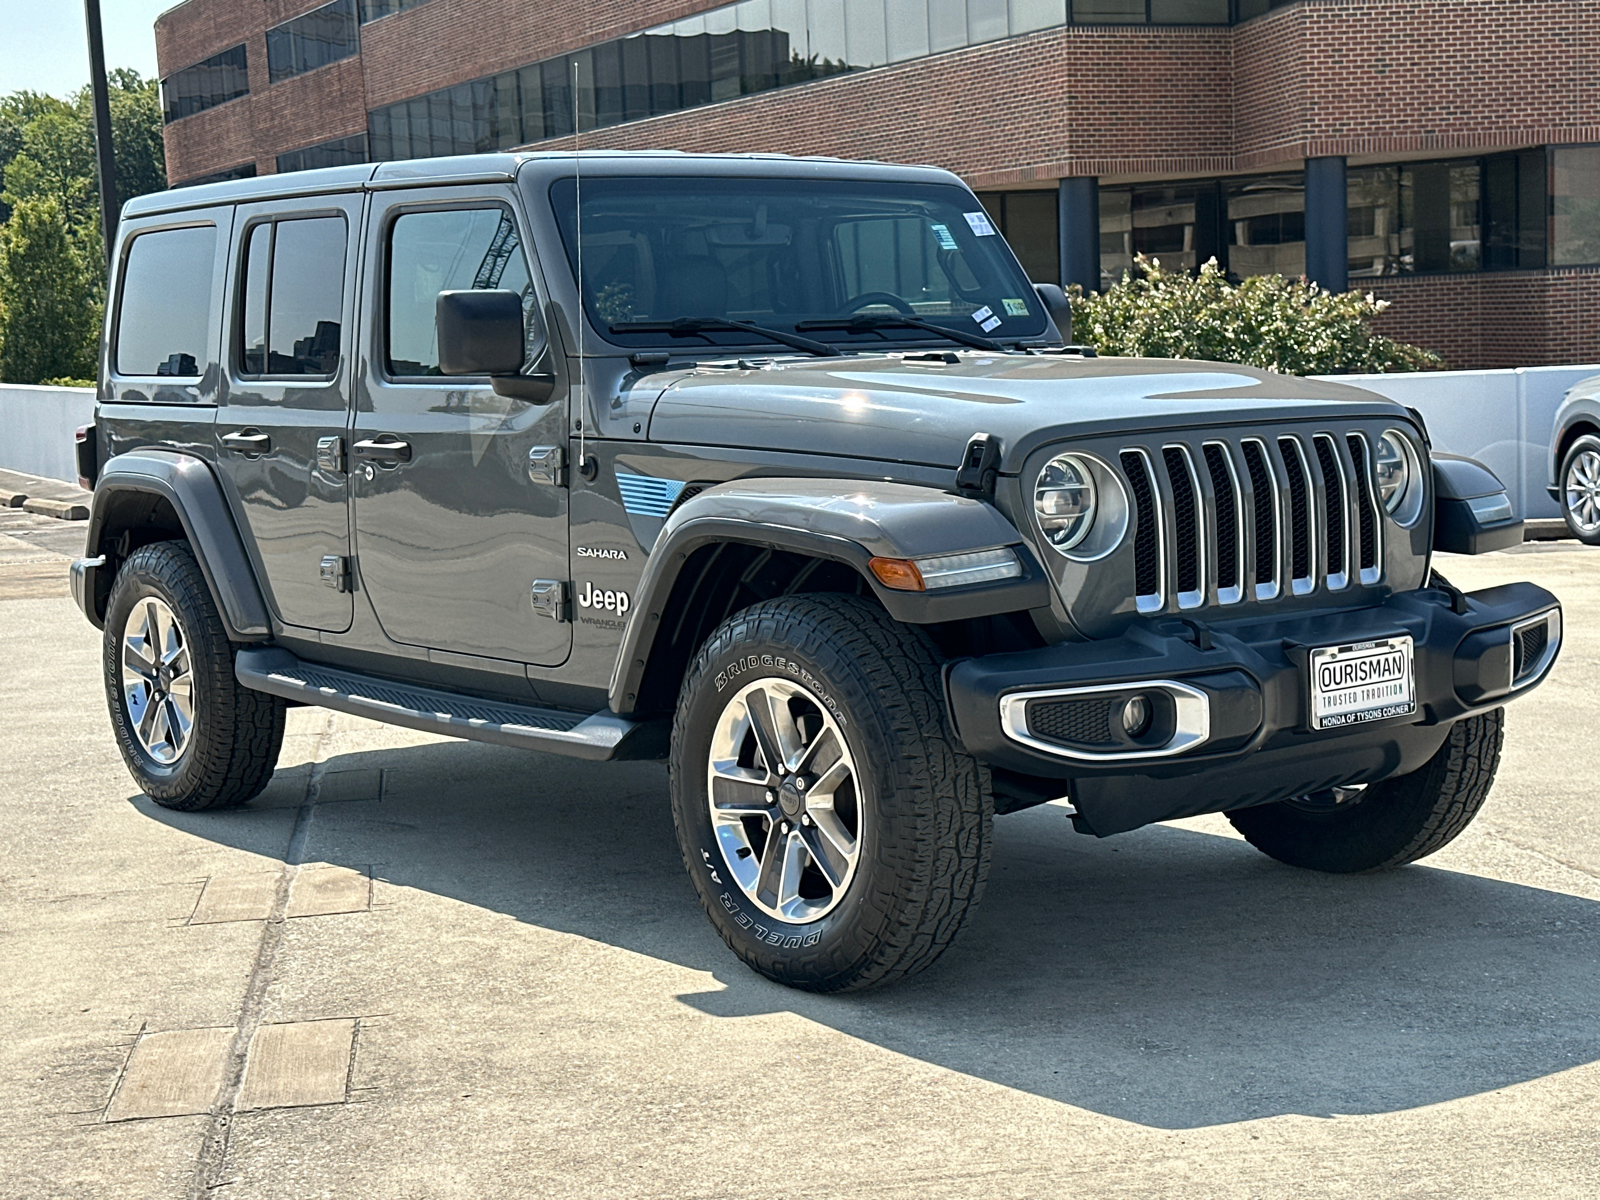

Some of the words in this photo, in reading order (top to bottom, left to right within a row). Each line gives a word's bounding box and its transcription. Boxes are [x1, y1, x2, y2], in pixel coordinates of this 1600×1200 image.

[577, 547, 628, 560] SAHARA
[579, 581, 630, 617] Jeep
[1322, 655, 1402, 688] OURISMAN
[108, 631, 144, 767] BRIDGESTONE
[714, 654, 848, 726] BRIDGESTONE
[1322, 691, 1357, 708] TRUSTED
[1362, 683, 1403, 702] TRADITION
[1322, 716, 1346, 727] HONDA
[1346, 713, 1356, 722] OF
[1356, 709, 1382, 720] TYSONS
[1382, 705, 1409, 717] CORNER
[700, 848, 723, 885] A/T
[719, 892, 823, 949] DUELER
